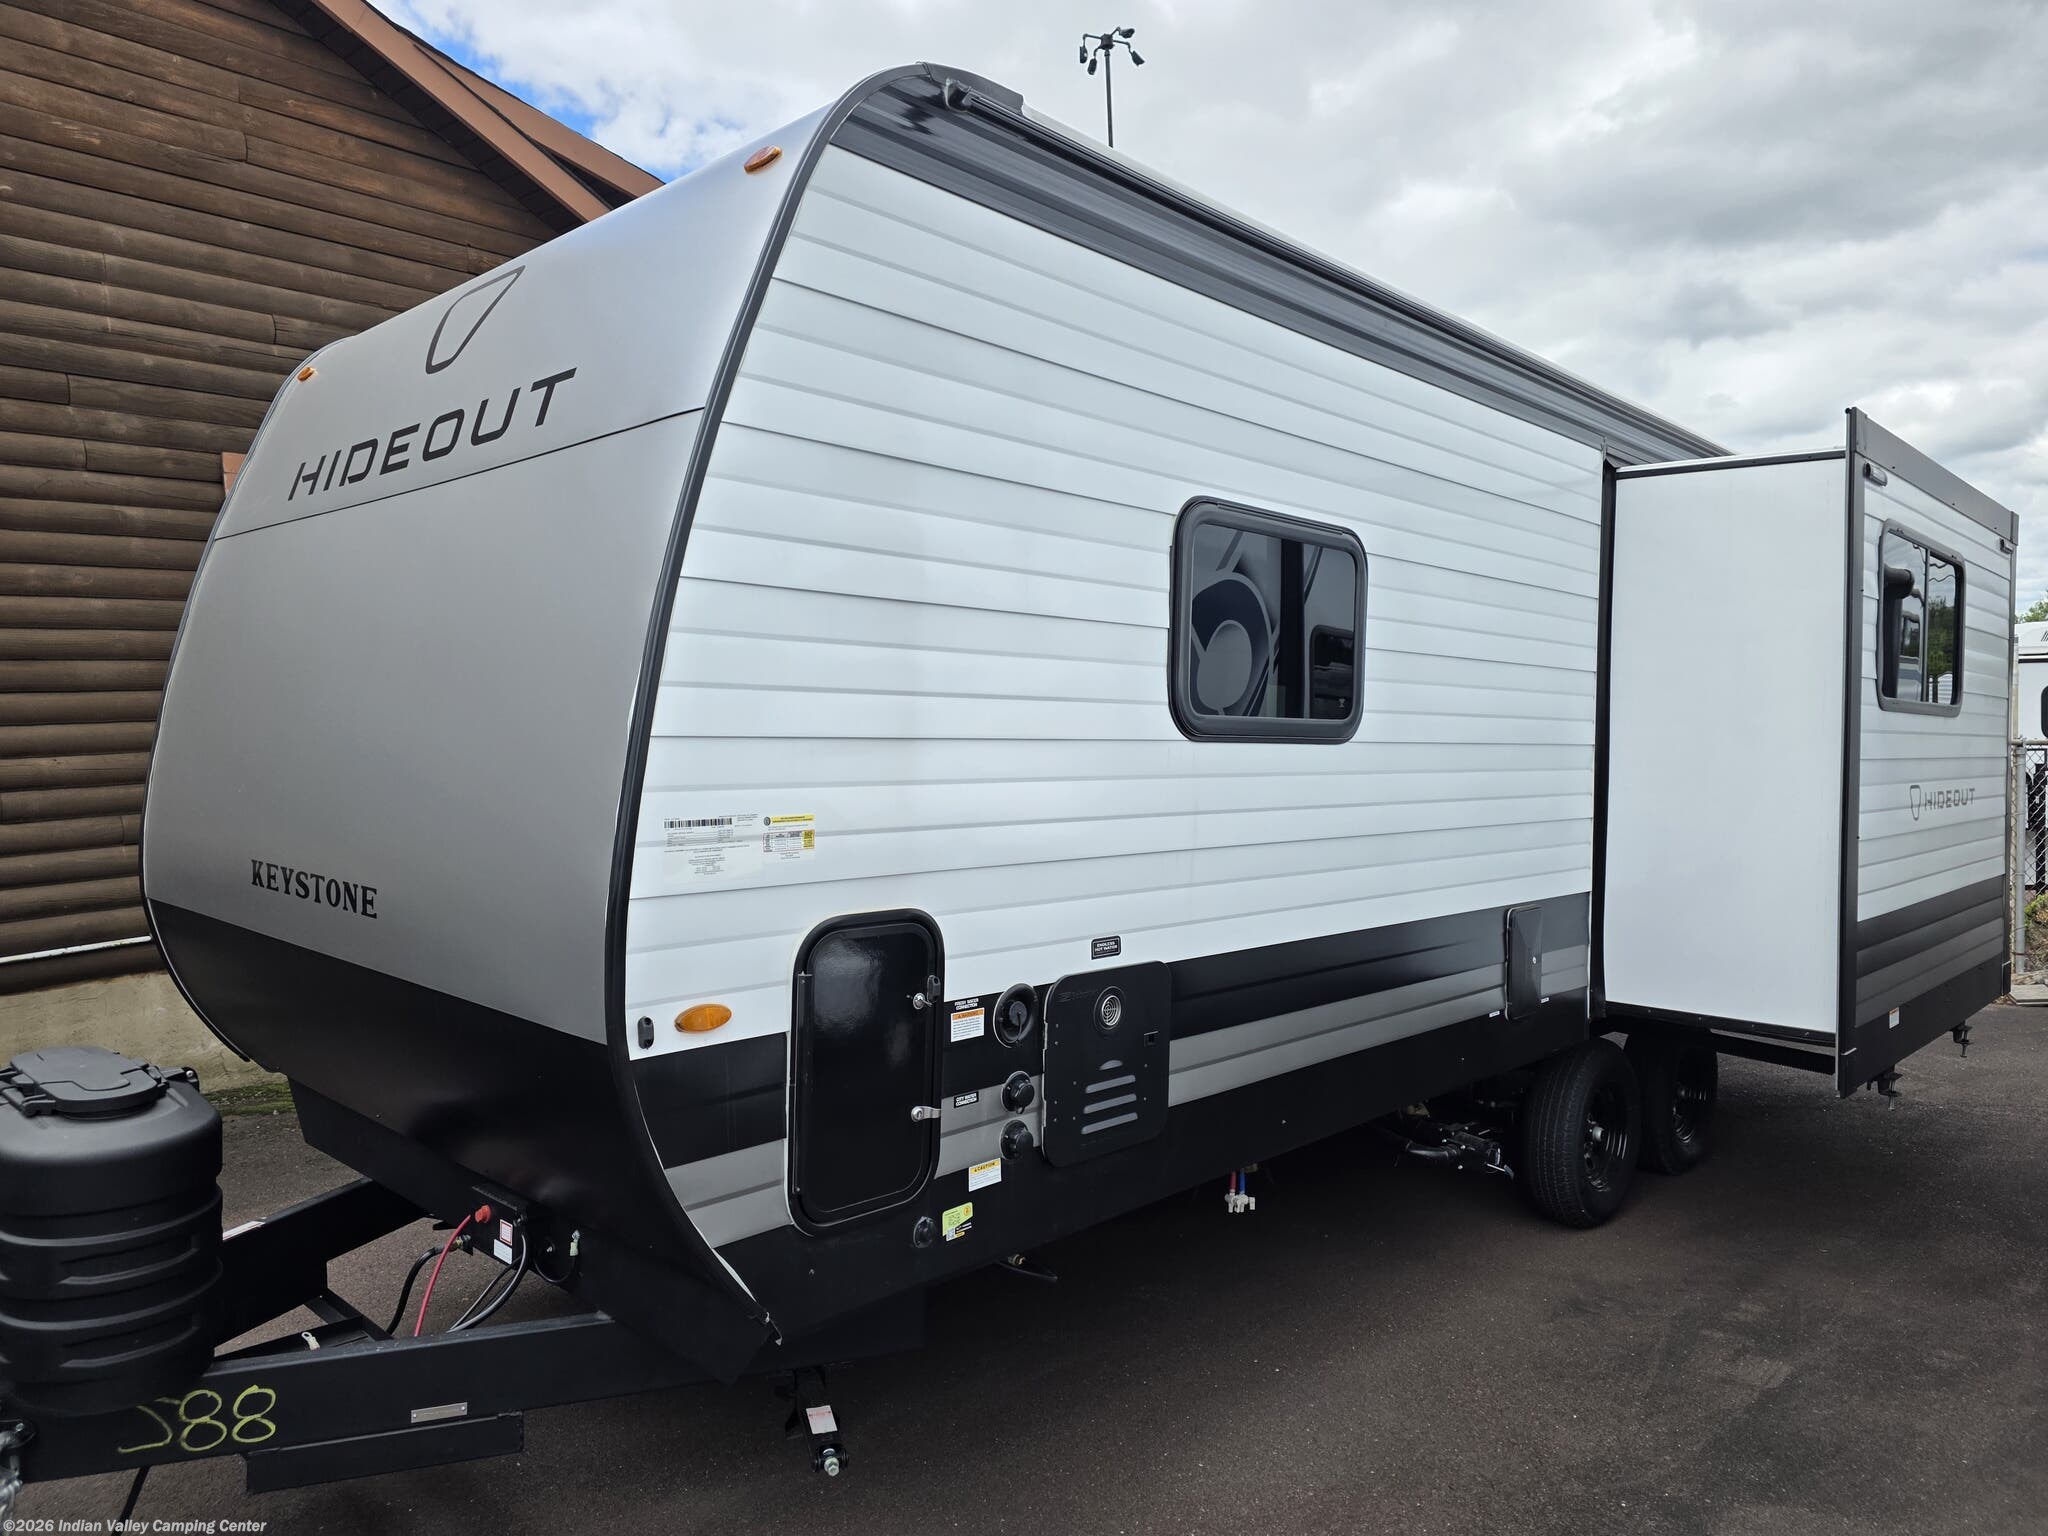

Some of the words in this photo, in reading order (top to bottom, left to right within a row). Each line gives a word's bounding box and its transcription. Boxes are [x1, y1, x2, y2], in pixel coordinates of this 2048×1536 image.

[288, 367, 577, 501] HIDEOUT
[1925, 788, 1975, 811] HIDEOUT
[251, 859, 377, 919] KEYSTONE
[977, 1162, 996, 1171] CAUTION
